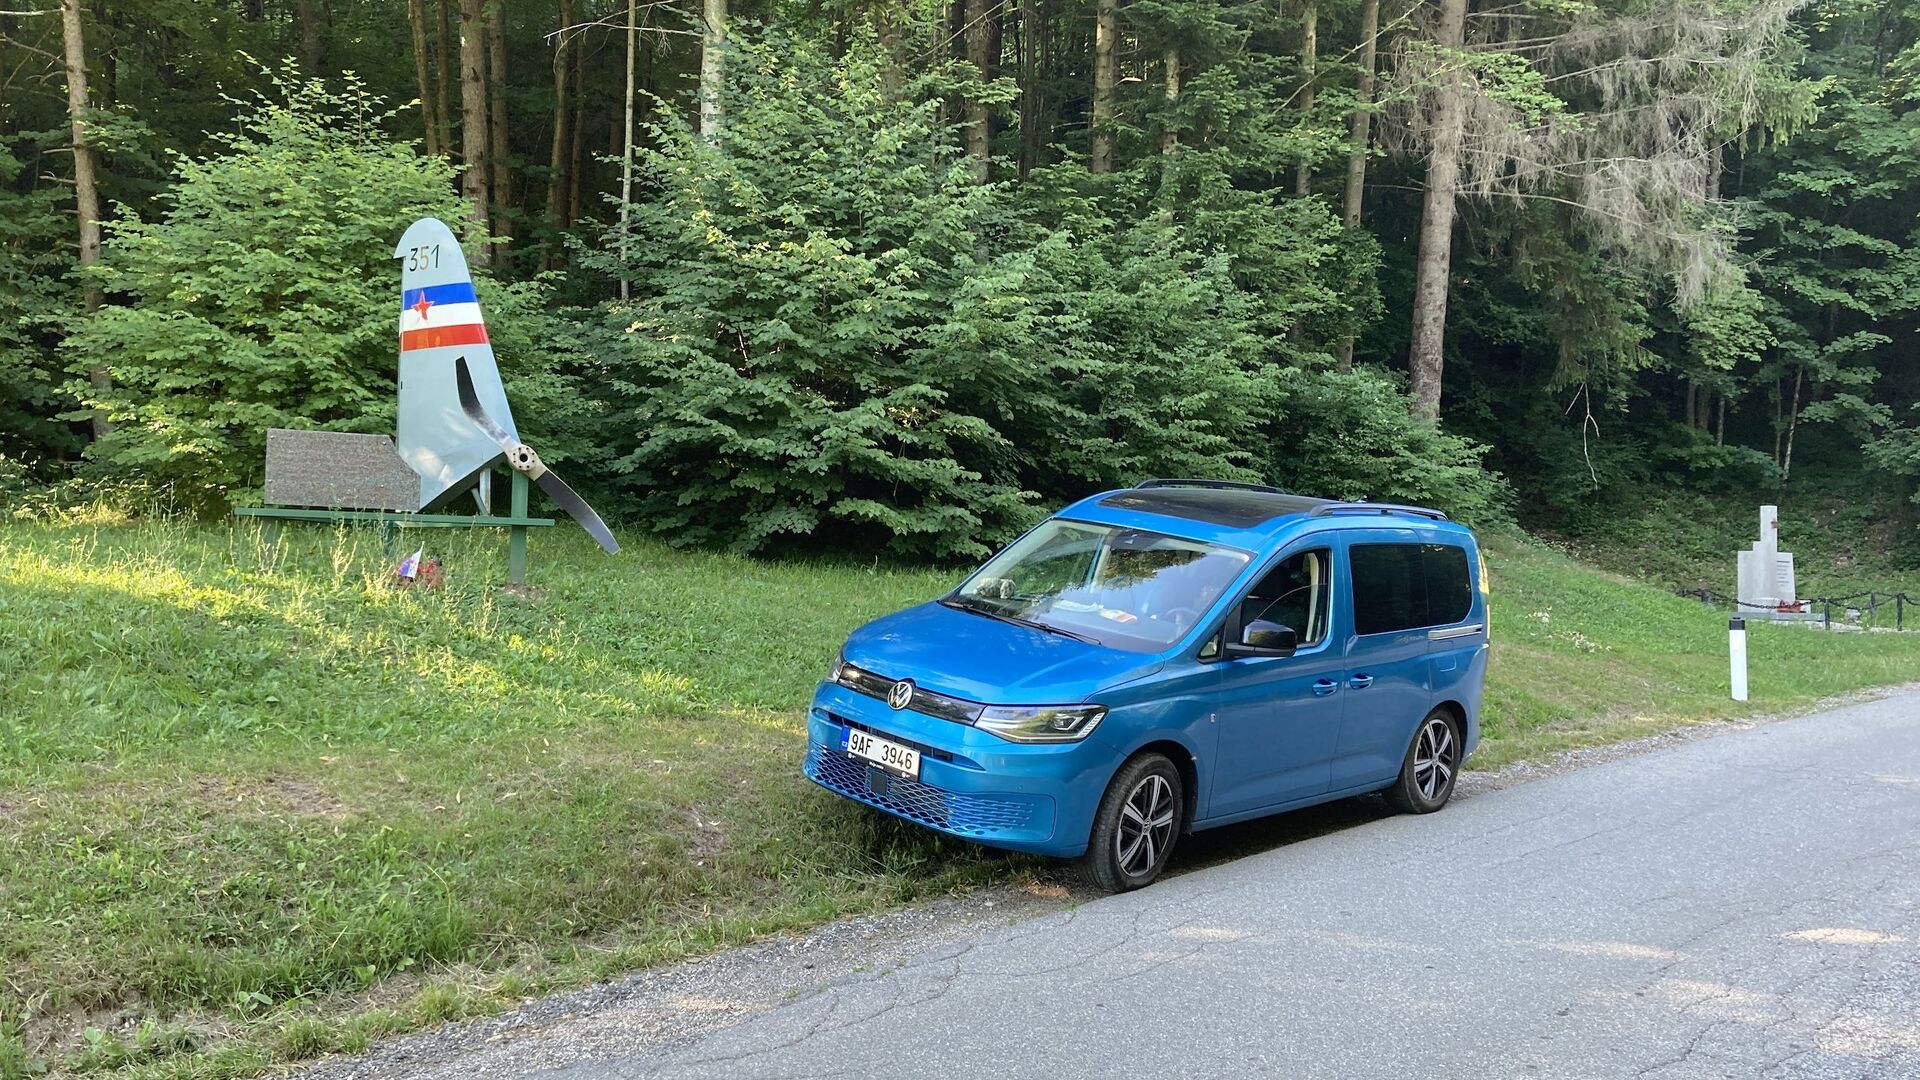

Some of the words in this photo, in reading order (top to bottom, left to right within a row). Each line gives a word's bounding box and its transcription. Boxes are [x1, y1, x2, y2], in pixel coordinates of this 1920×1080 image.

[409, 244, 440, 272] 351
[851, 734, 873, 755] 9AF
[882, 745, 912, 770] 3946
